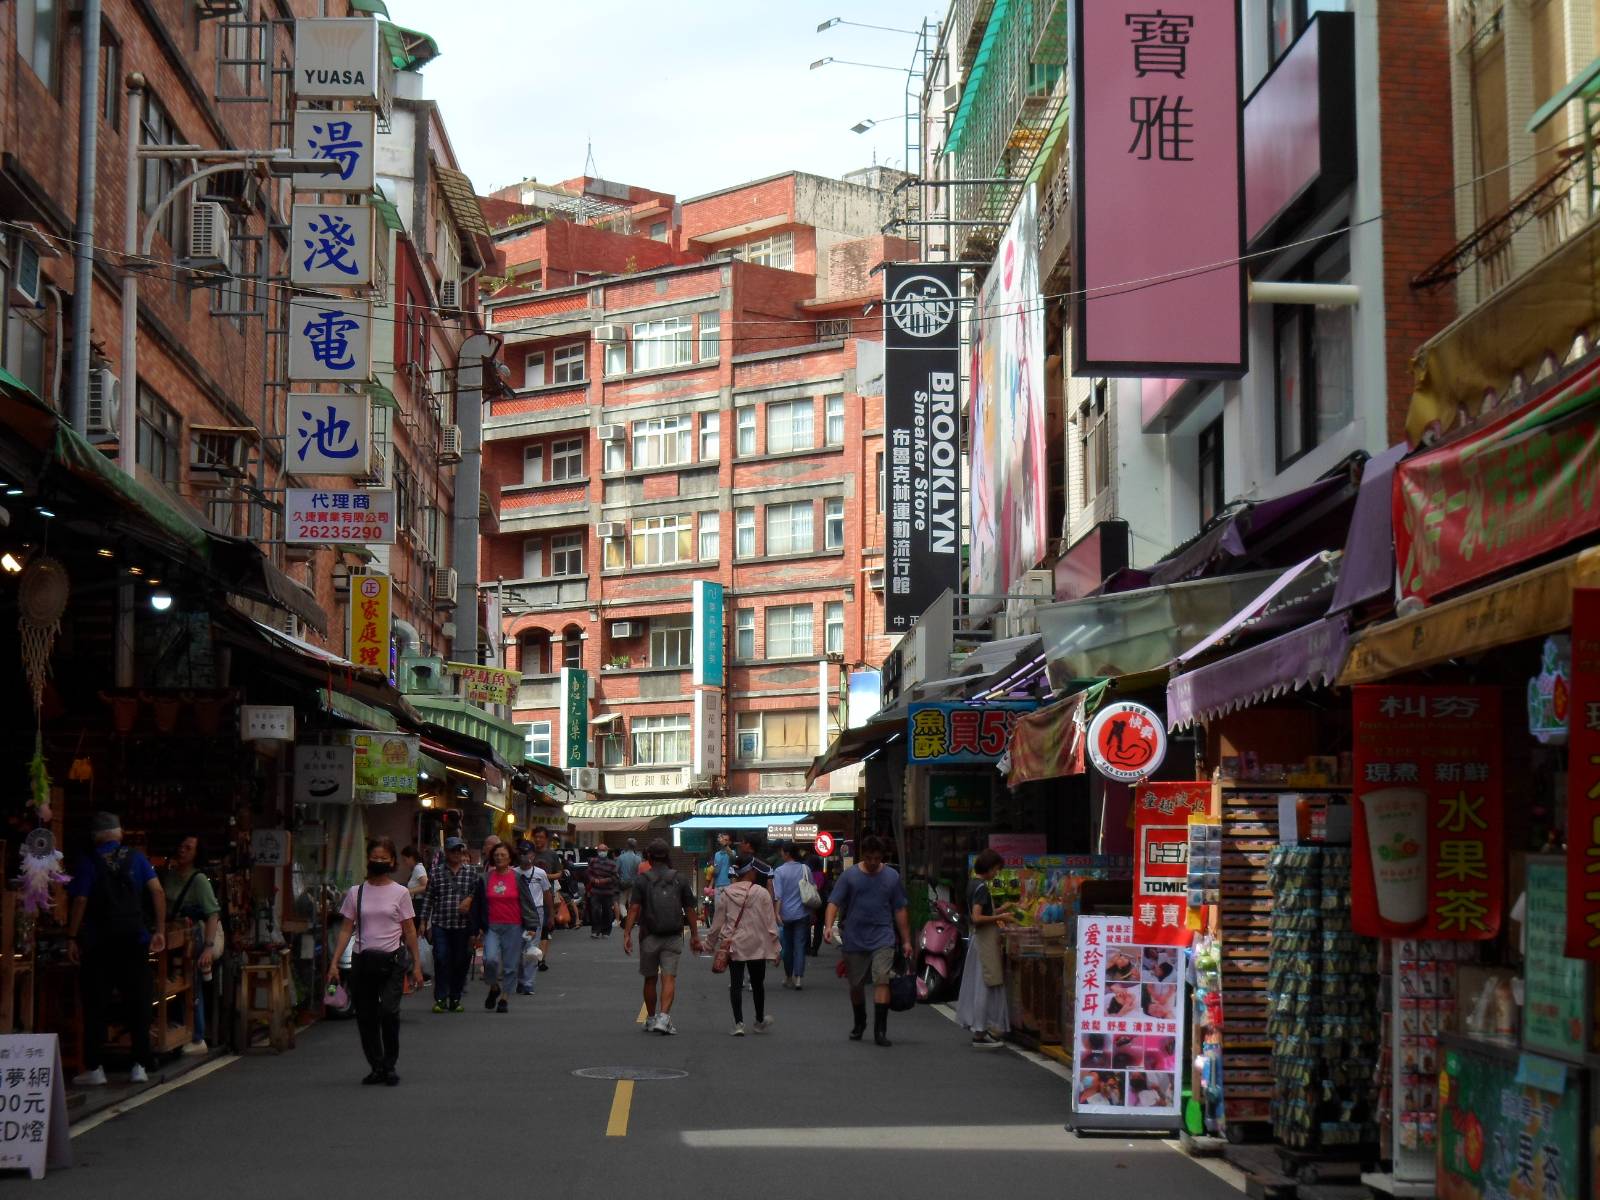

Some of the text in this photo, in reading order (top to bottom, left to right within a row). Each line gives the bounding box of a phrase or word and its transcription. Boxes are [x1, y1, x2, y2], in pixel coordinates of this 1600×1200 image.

[305, 69, 365, 86] YUASA
[1125, 9, 1195, 162] 寶雅
[913, 390, 929, 532] Sneaker Store
[930, 371, 956, 555] BROOKLYN
[311, 493, 371, 510] 代理商
[892, 428, 911, 595] 布魯克林運動流行館
[299, 526, 382, 539] 26235290
[912, 708, 947, 759] 魚酥
[1115, 767, 1145, 777] EXPRESS
[1364, 762, 1489, 783] 現煮 新鮮
[1435, 789, 1489, 932] 水果茶
[1138, 903, 1187, 928] 專賣
[0, 1066, 51, 1088] 夢網
